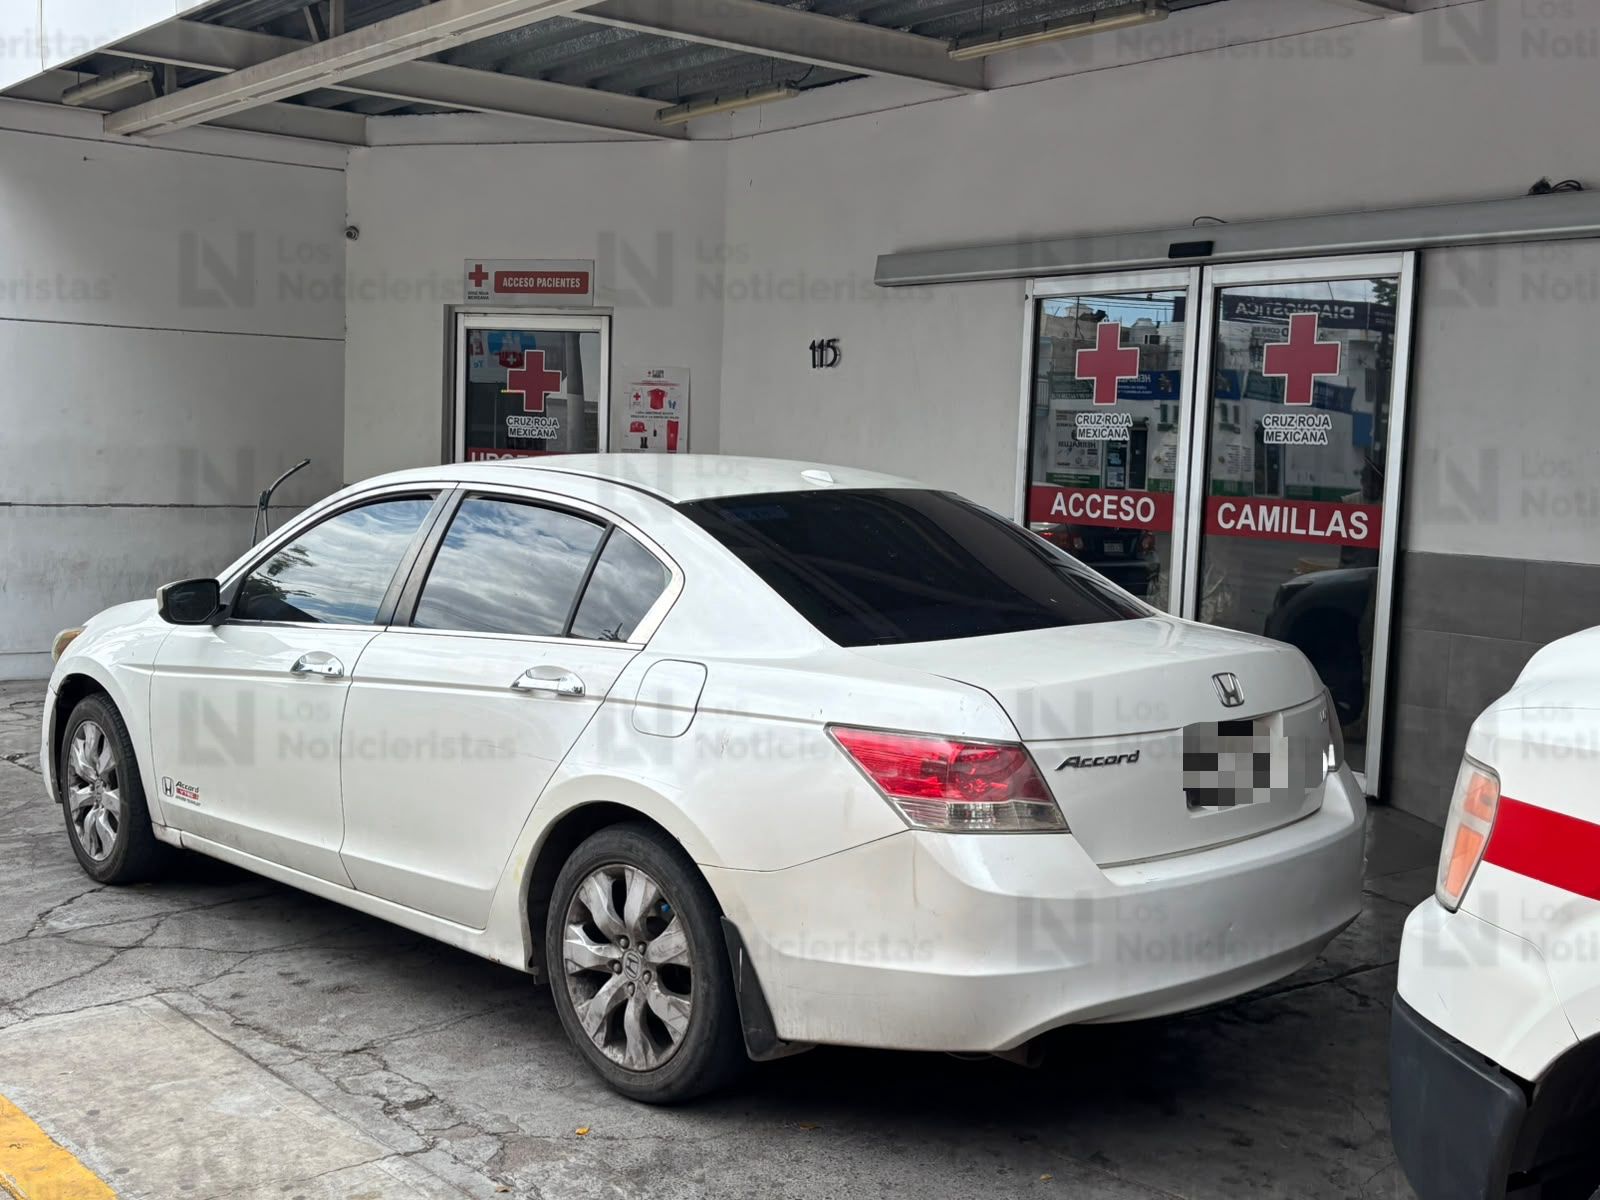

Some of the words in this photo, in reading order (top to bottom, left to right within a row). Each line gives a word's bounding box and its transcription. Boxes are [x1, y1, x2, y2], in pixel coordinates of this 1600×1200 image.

[502, 277, 534, 288] ACCESO
[536, 277, 581, 288] PACIENTES
[809, 338, 841, 368] 115
[506, 416, 532, 427] CRUZ
[533, 417, 559, 428] ROJA
[1075, 414, 1102, 425] CRUZ
[1103, 414, 1133, 426] ROJA
[1263, 414, 1297, 428] CRUZ
[1298, 415, 1331, 429] ROJA
[508, 427, 557, 438] MEXICANA
[1077, 428, 1129, 440] MEXICANA
[1264, 430, 1328, 444] MEXICANA
[1050, 491, 1156, 523] ACCESO
[1217, 502, 1369, 540] CAMILLAS
[1055, 750, 1140, 771] Accord
[176, 781, 200, 793] Accord
